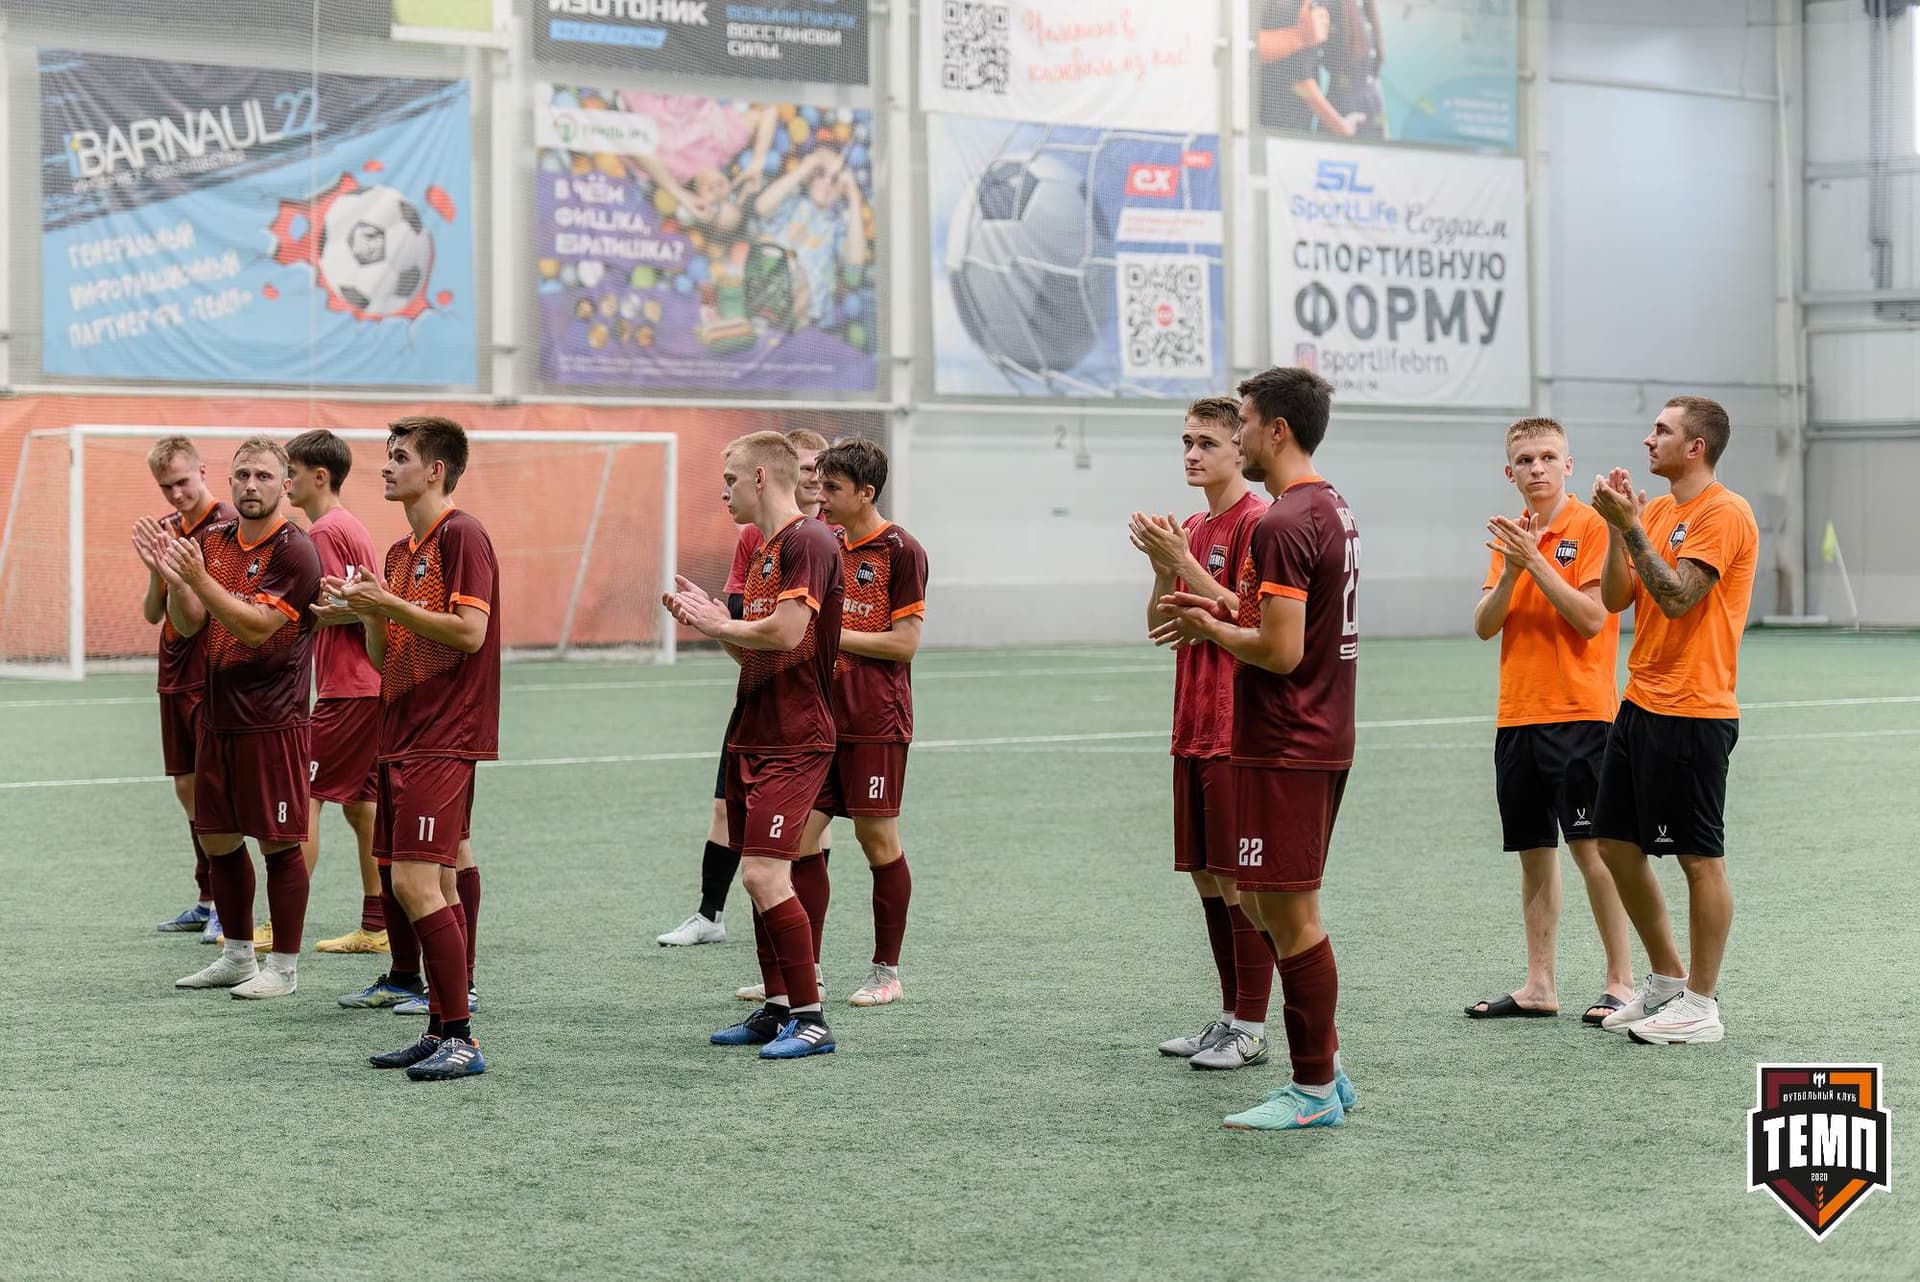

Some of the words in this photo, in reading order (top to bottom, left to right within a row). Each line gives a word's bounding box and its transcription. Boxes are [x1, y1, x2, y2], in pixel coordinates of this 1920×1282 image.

[555, 179, 571, 200] В
[1293, 239, 1507, 281] СПОРТИВНУЮ
[1294, 280, 1504, 346] ФОРМУ
[868, 776, 885, 799] 21
[277, 801, 288, 824] 8
[418, 816, 435, 842] 11
[769, 814, 784, 839] 2
[1238, 838, 1263, 867] 22
